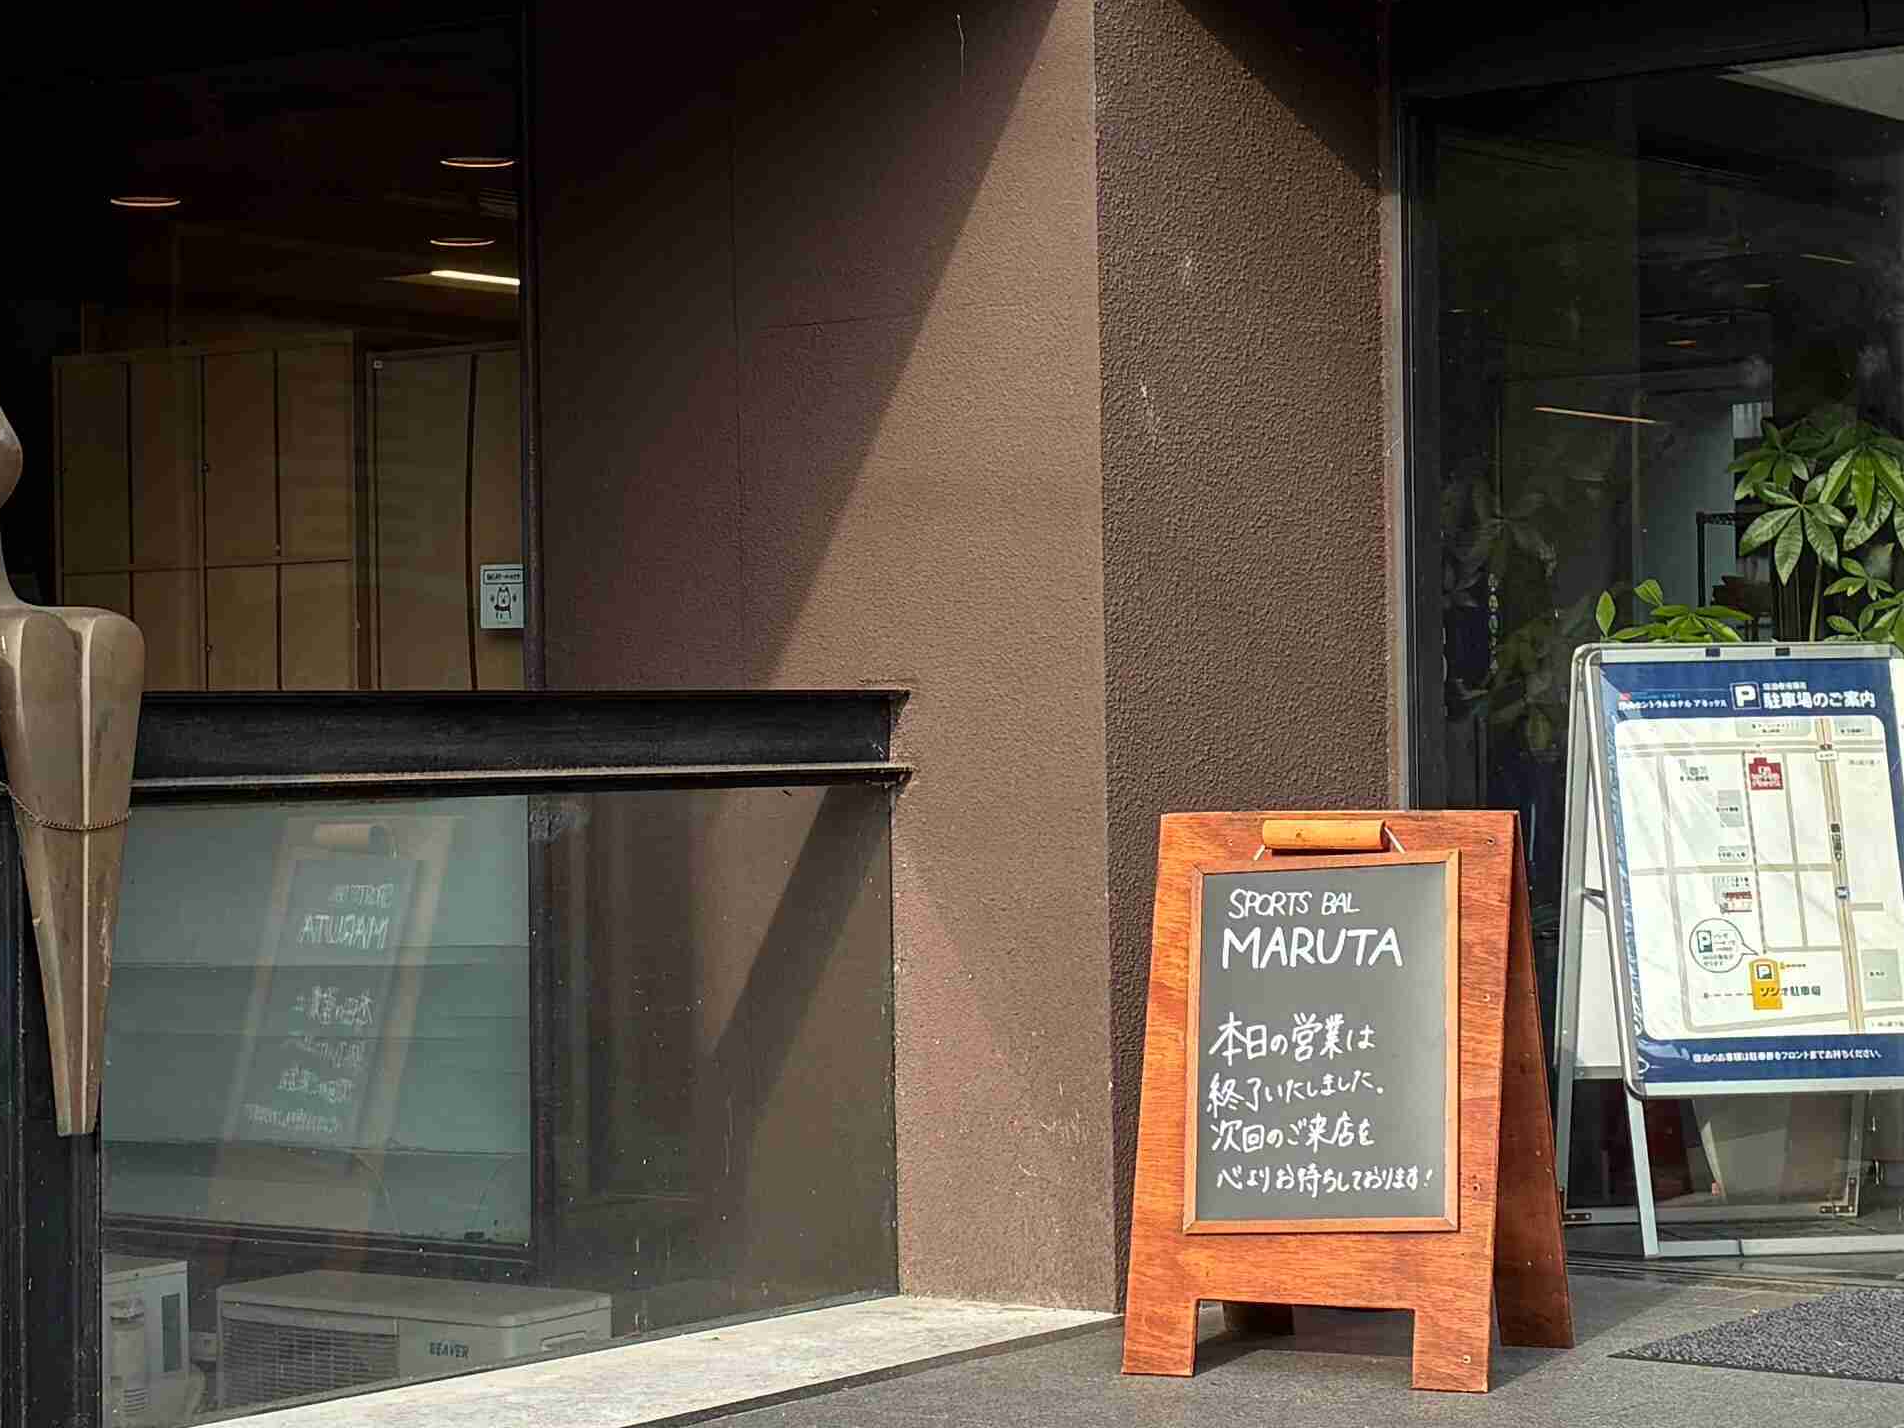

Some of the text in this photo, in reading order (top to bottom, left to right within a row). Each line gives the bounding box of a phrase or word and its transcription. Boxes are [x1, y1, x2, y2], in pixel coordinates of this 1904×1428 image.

[1733, 685, 1757, 708] P
[1762, 689, 1877, 710] 駐車場のご案内
[1227, 888, 1361, 920] SPORTS BAL
[1221, 926, 1404, 969] MARUTA
[1207, 1011, 1377, 1067] 本日の営業は
[1206, 1070, 1385, 1119] 終了いたしました。
[1209, 1110, 1376, 1154] 次回のご来店を
